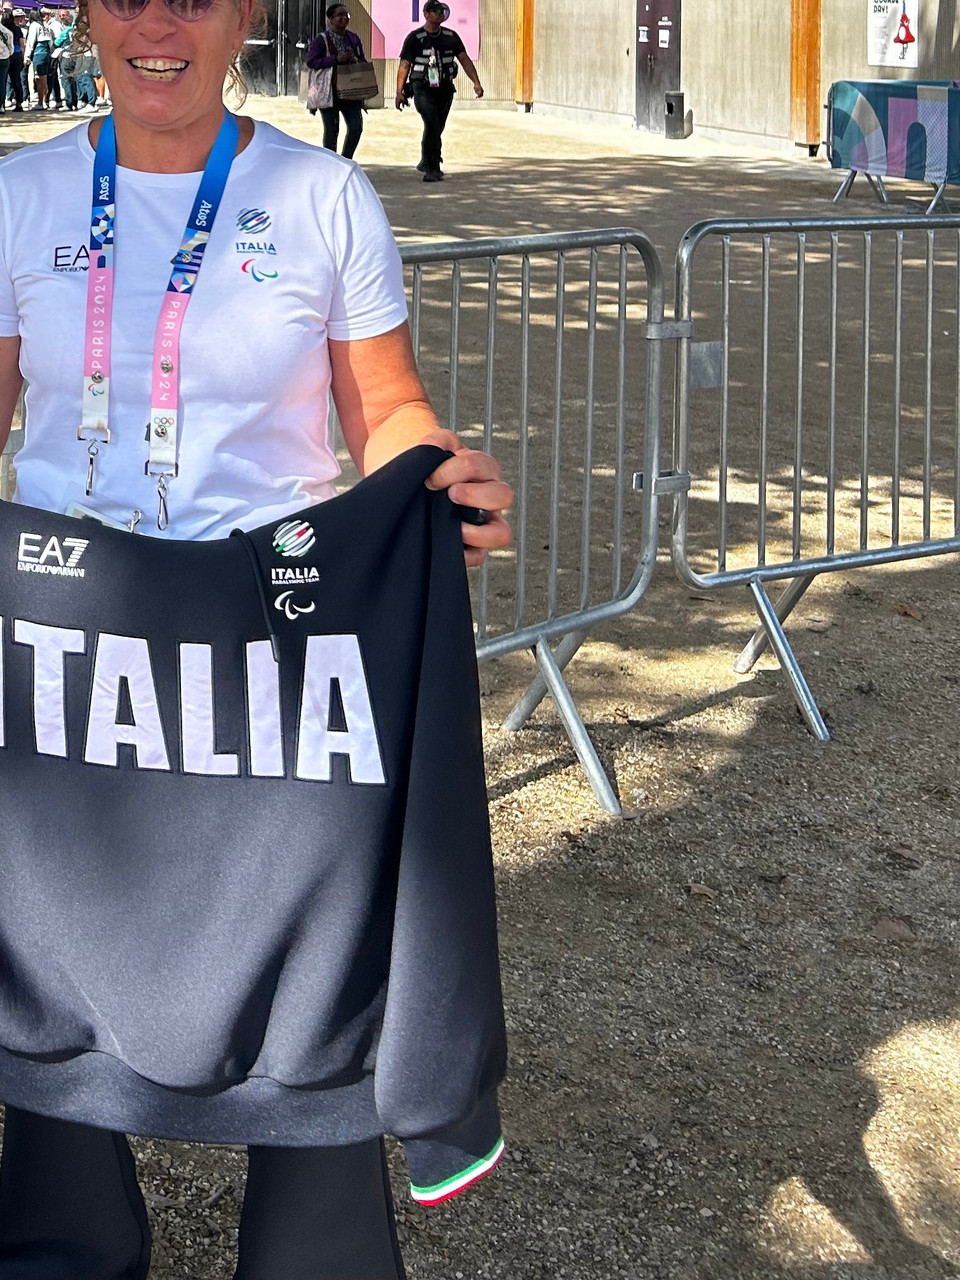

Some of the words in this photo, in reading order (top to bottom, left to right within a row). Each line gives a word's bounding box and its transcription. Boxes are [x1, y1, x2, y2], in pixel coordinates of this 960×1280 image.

[54, 245, 90, 267] EA
[236, 242, 277, 252] ITALIA
[94, 275, 107, 315] 2024
[161, 300, 181, 348] PARIS
[91, 320, 105, 369] PARIS
[159, 354, 174, 401] 224
[18, 532, 90, 567] EA7
[271, 567, 320, 580] ITALIA
